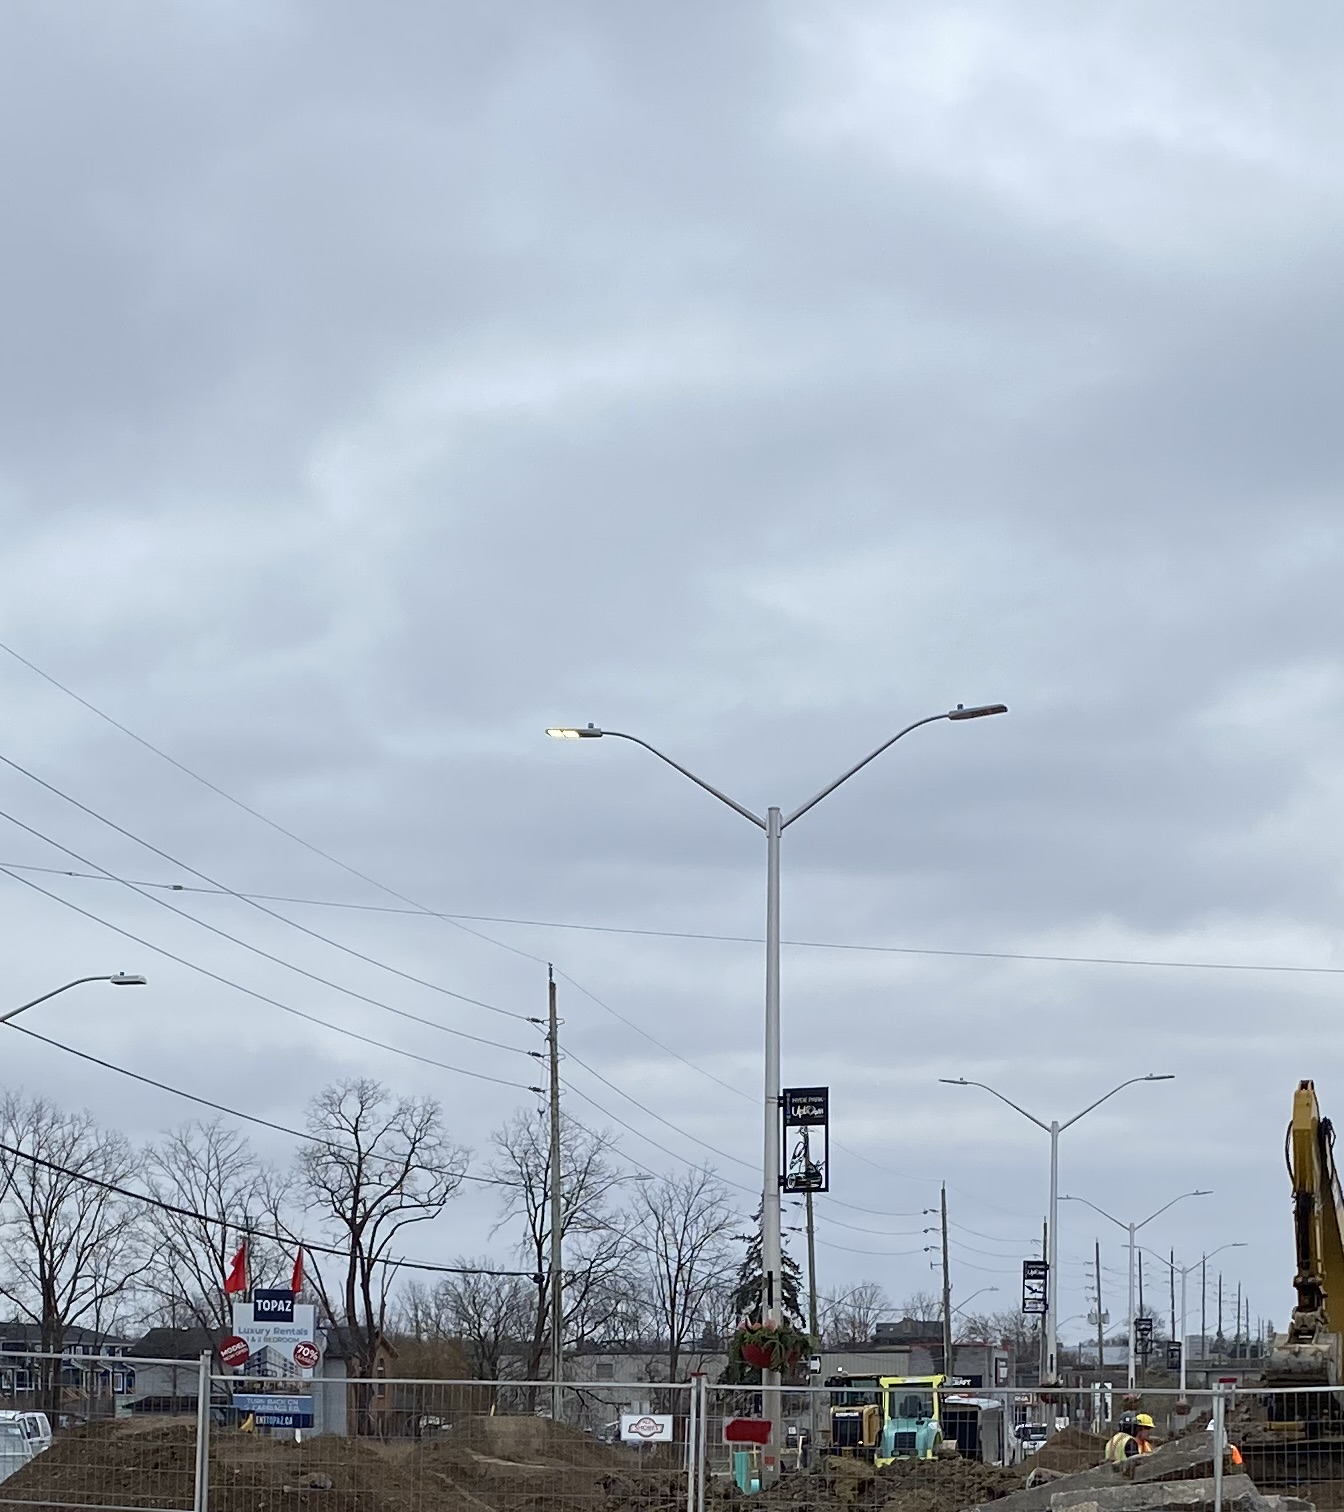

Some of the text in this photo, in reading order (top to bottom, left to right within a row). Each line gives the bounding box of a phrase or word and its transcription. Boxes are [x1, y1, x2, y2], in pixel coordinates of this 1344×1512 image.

[256, 1299, 292, 1312] TOPAZ
[238, 1326, 309, 1336] Luxury Rentals
[220, 1341, 247, 1357] MODEL
[296, 1344, 318, 1361] 70%
